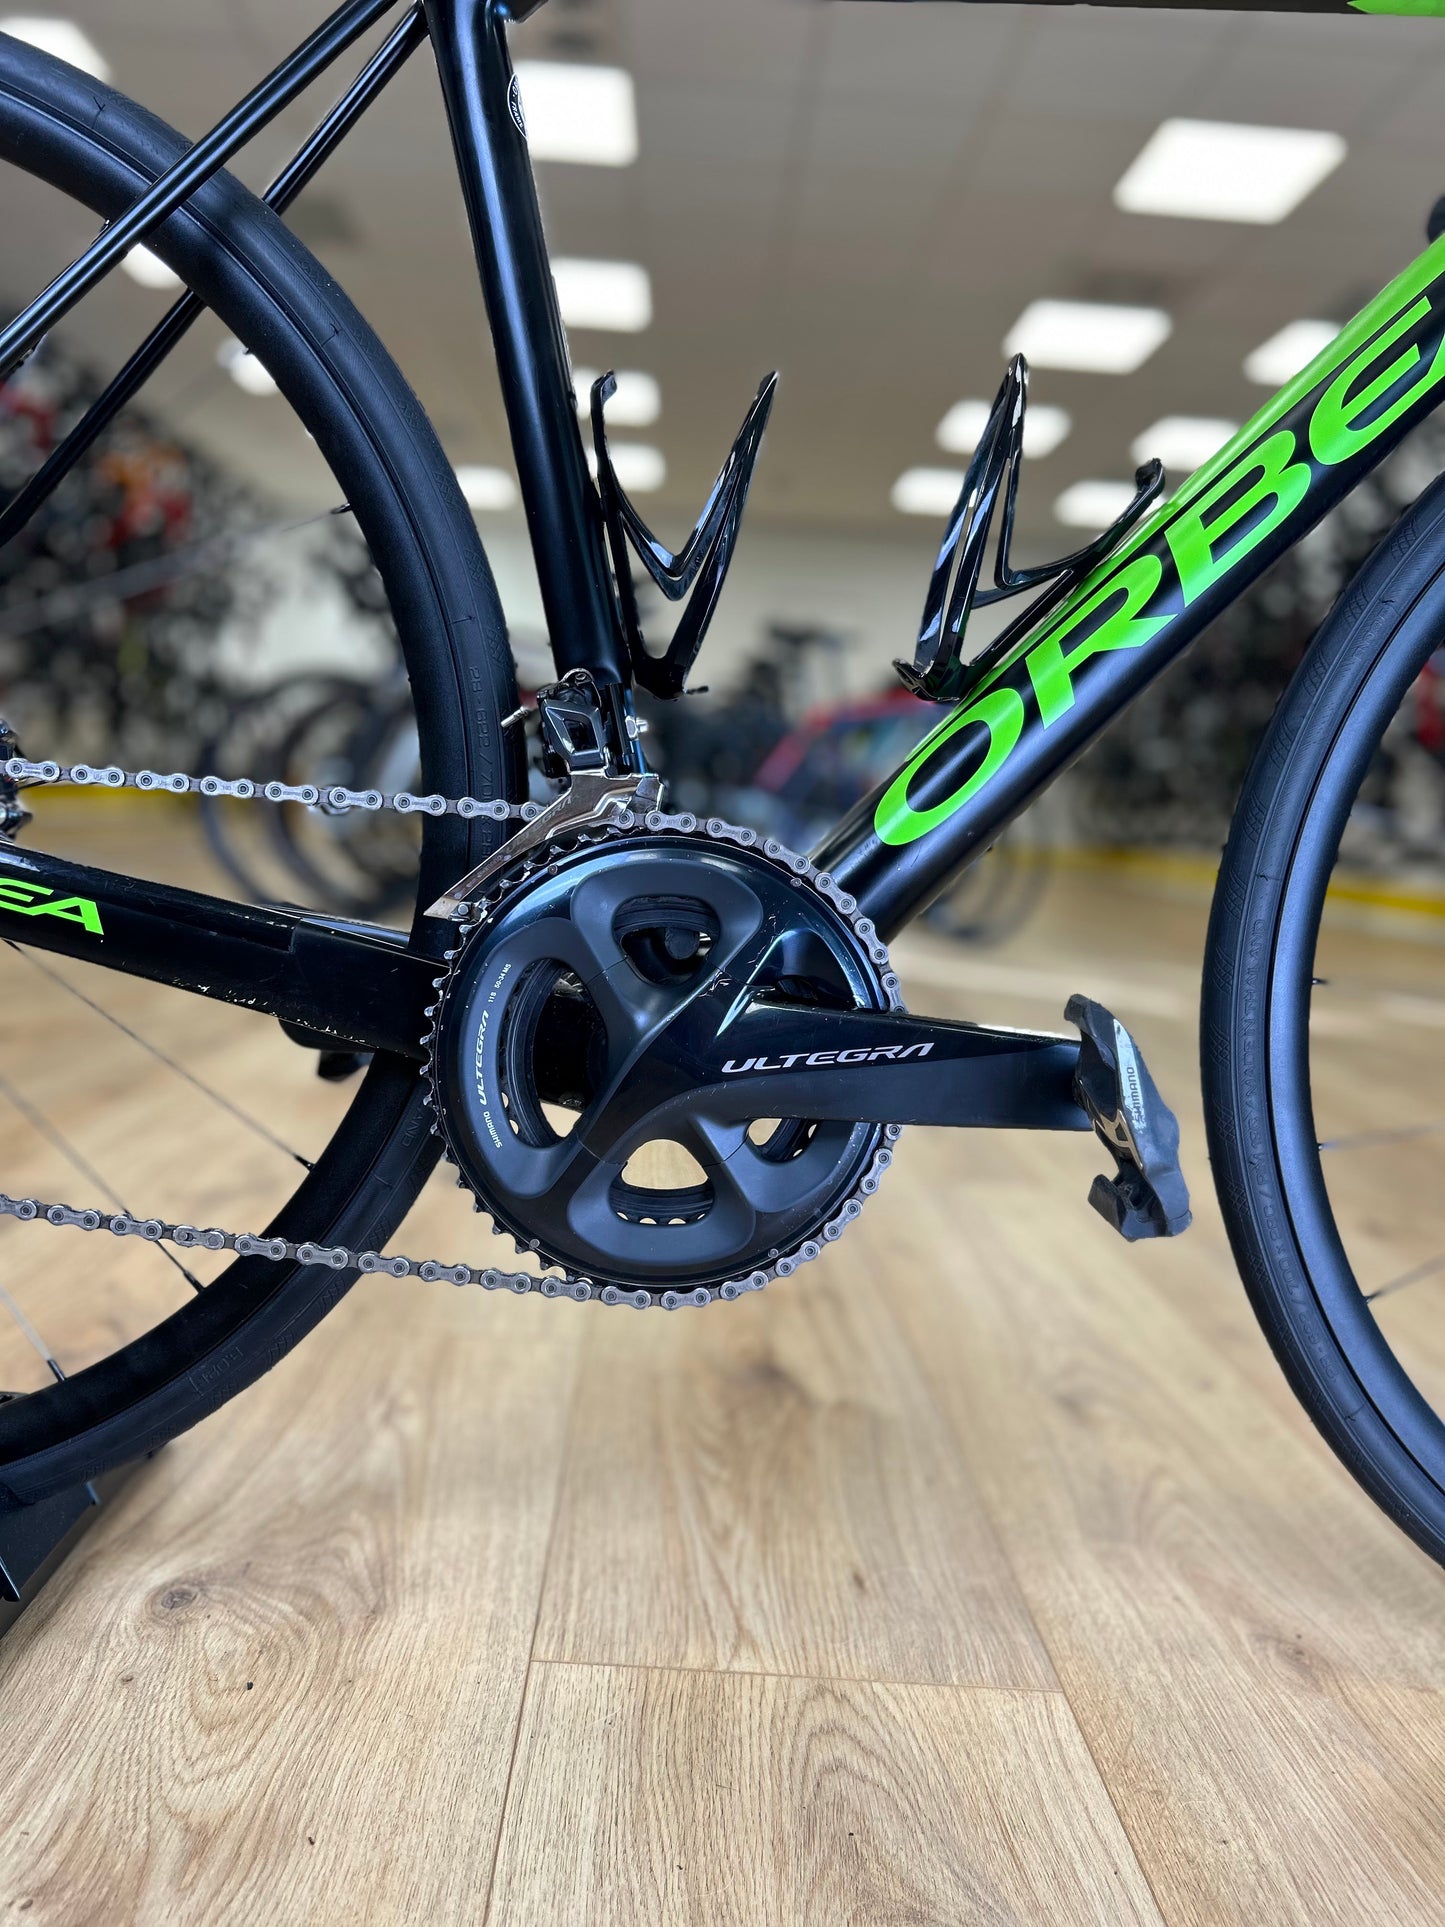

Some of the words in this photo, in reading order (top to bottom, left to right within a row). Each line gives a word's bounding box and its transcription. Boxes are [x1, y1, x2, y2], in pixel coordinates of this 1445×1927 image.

[874, 295, 1445, 846] ORBE
[475, 1009, 489, 1106] ULTEGRA
[721, 1042, 935, 1073] ULTEGRA
[483, 1111, 503, 1149] SHIMANO
